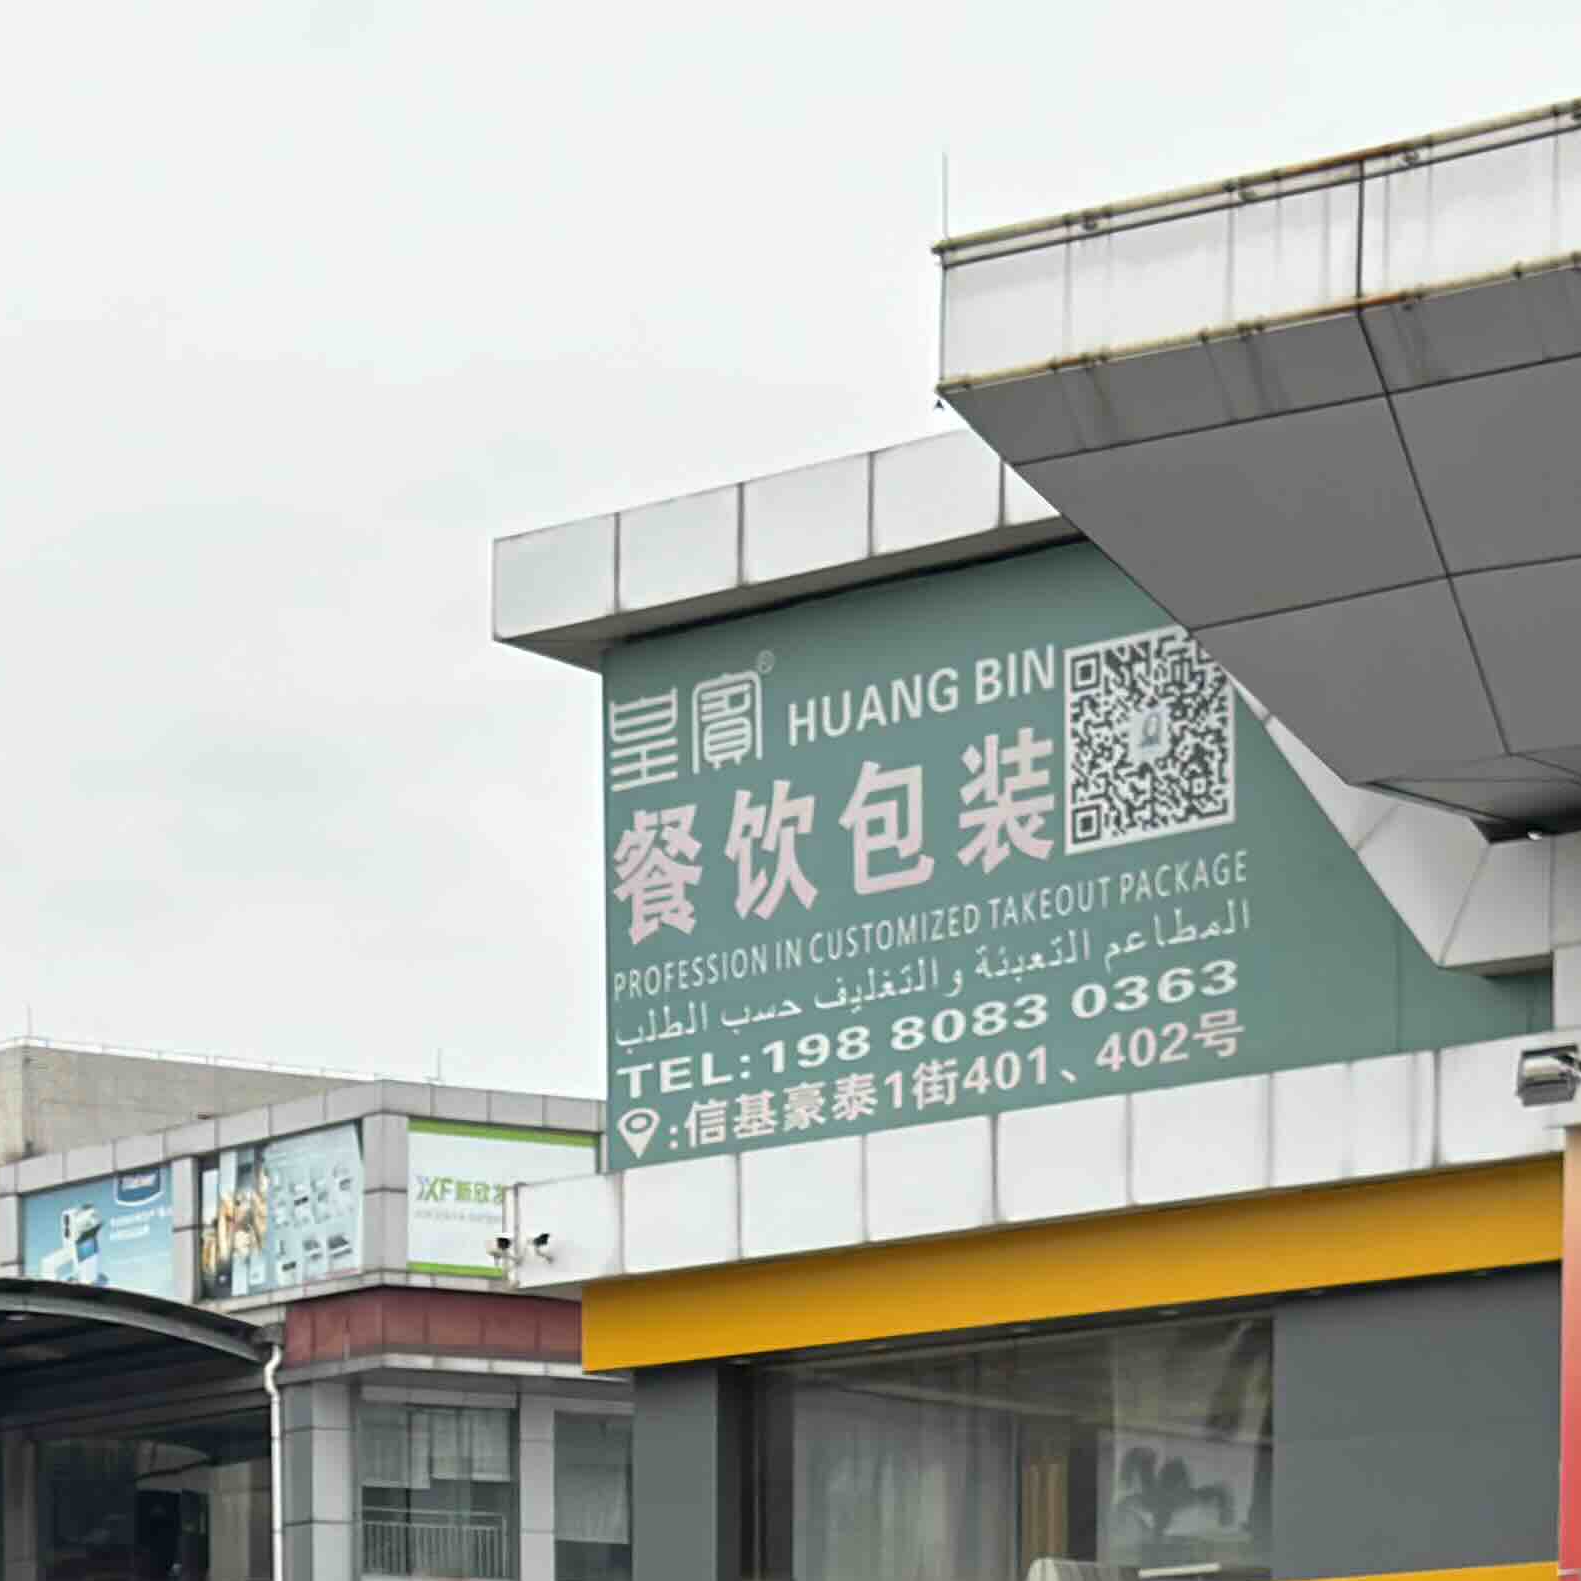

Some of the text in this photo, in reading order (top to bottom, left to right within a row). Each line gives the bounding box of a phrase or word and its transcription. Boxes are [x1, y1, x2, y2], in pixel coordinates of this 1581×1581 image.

[788, 644, 1057, 747] HUANG BIN
[613, 728, 1057, 945] 餐饮包装
[614, 850, 1249, 1002] PROFESSION IN CUSTOMIZED TAKEOUT PACKAGE
[890, 993, 1048, 1054] 8083
[1071, 959, 1238, 1020] 0363
